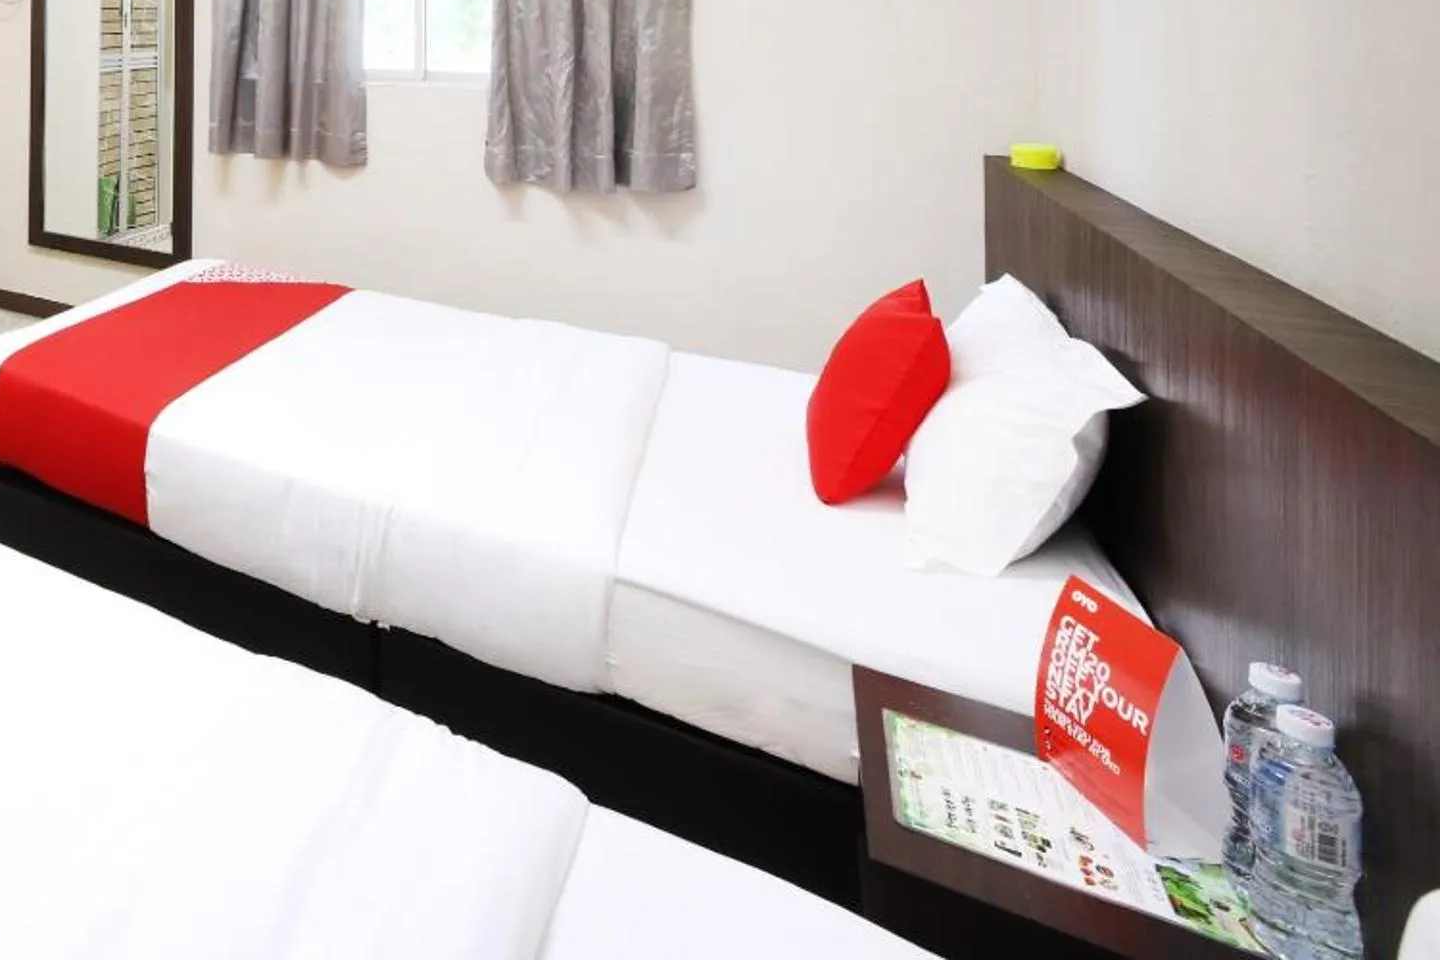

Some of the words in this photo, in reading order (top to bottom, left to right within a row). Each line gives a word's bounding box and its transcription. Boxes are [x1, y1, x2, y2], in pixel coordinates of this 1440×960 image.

[1071, 590, 1098, 614] OYO
[1056, 630, 1112, 683] RM20
[1060, 615, 1101, 652] GET
[1046, 680, 1092, 725] STAY
[1048, 665, 1099, 712] NEXT
[1051, 648, 1089, 687] OFF
[1092, 677, 1150, 735] YOUR
